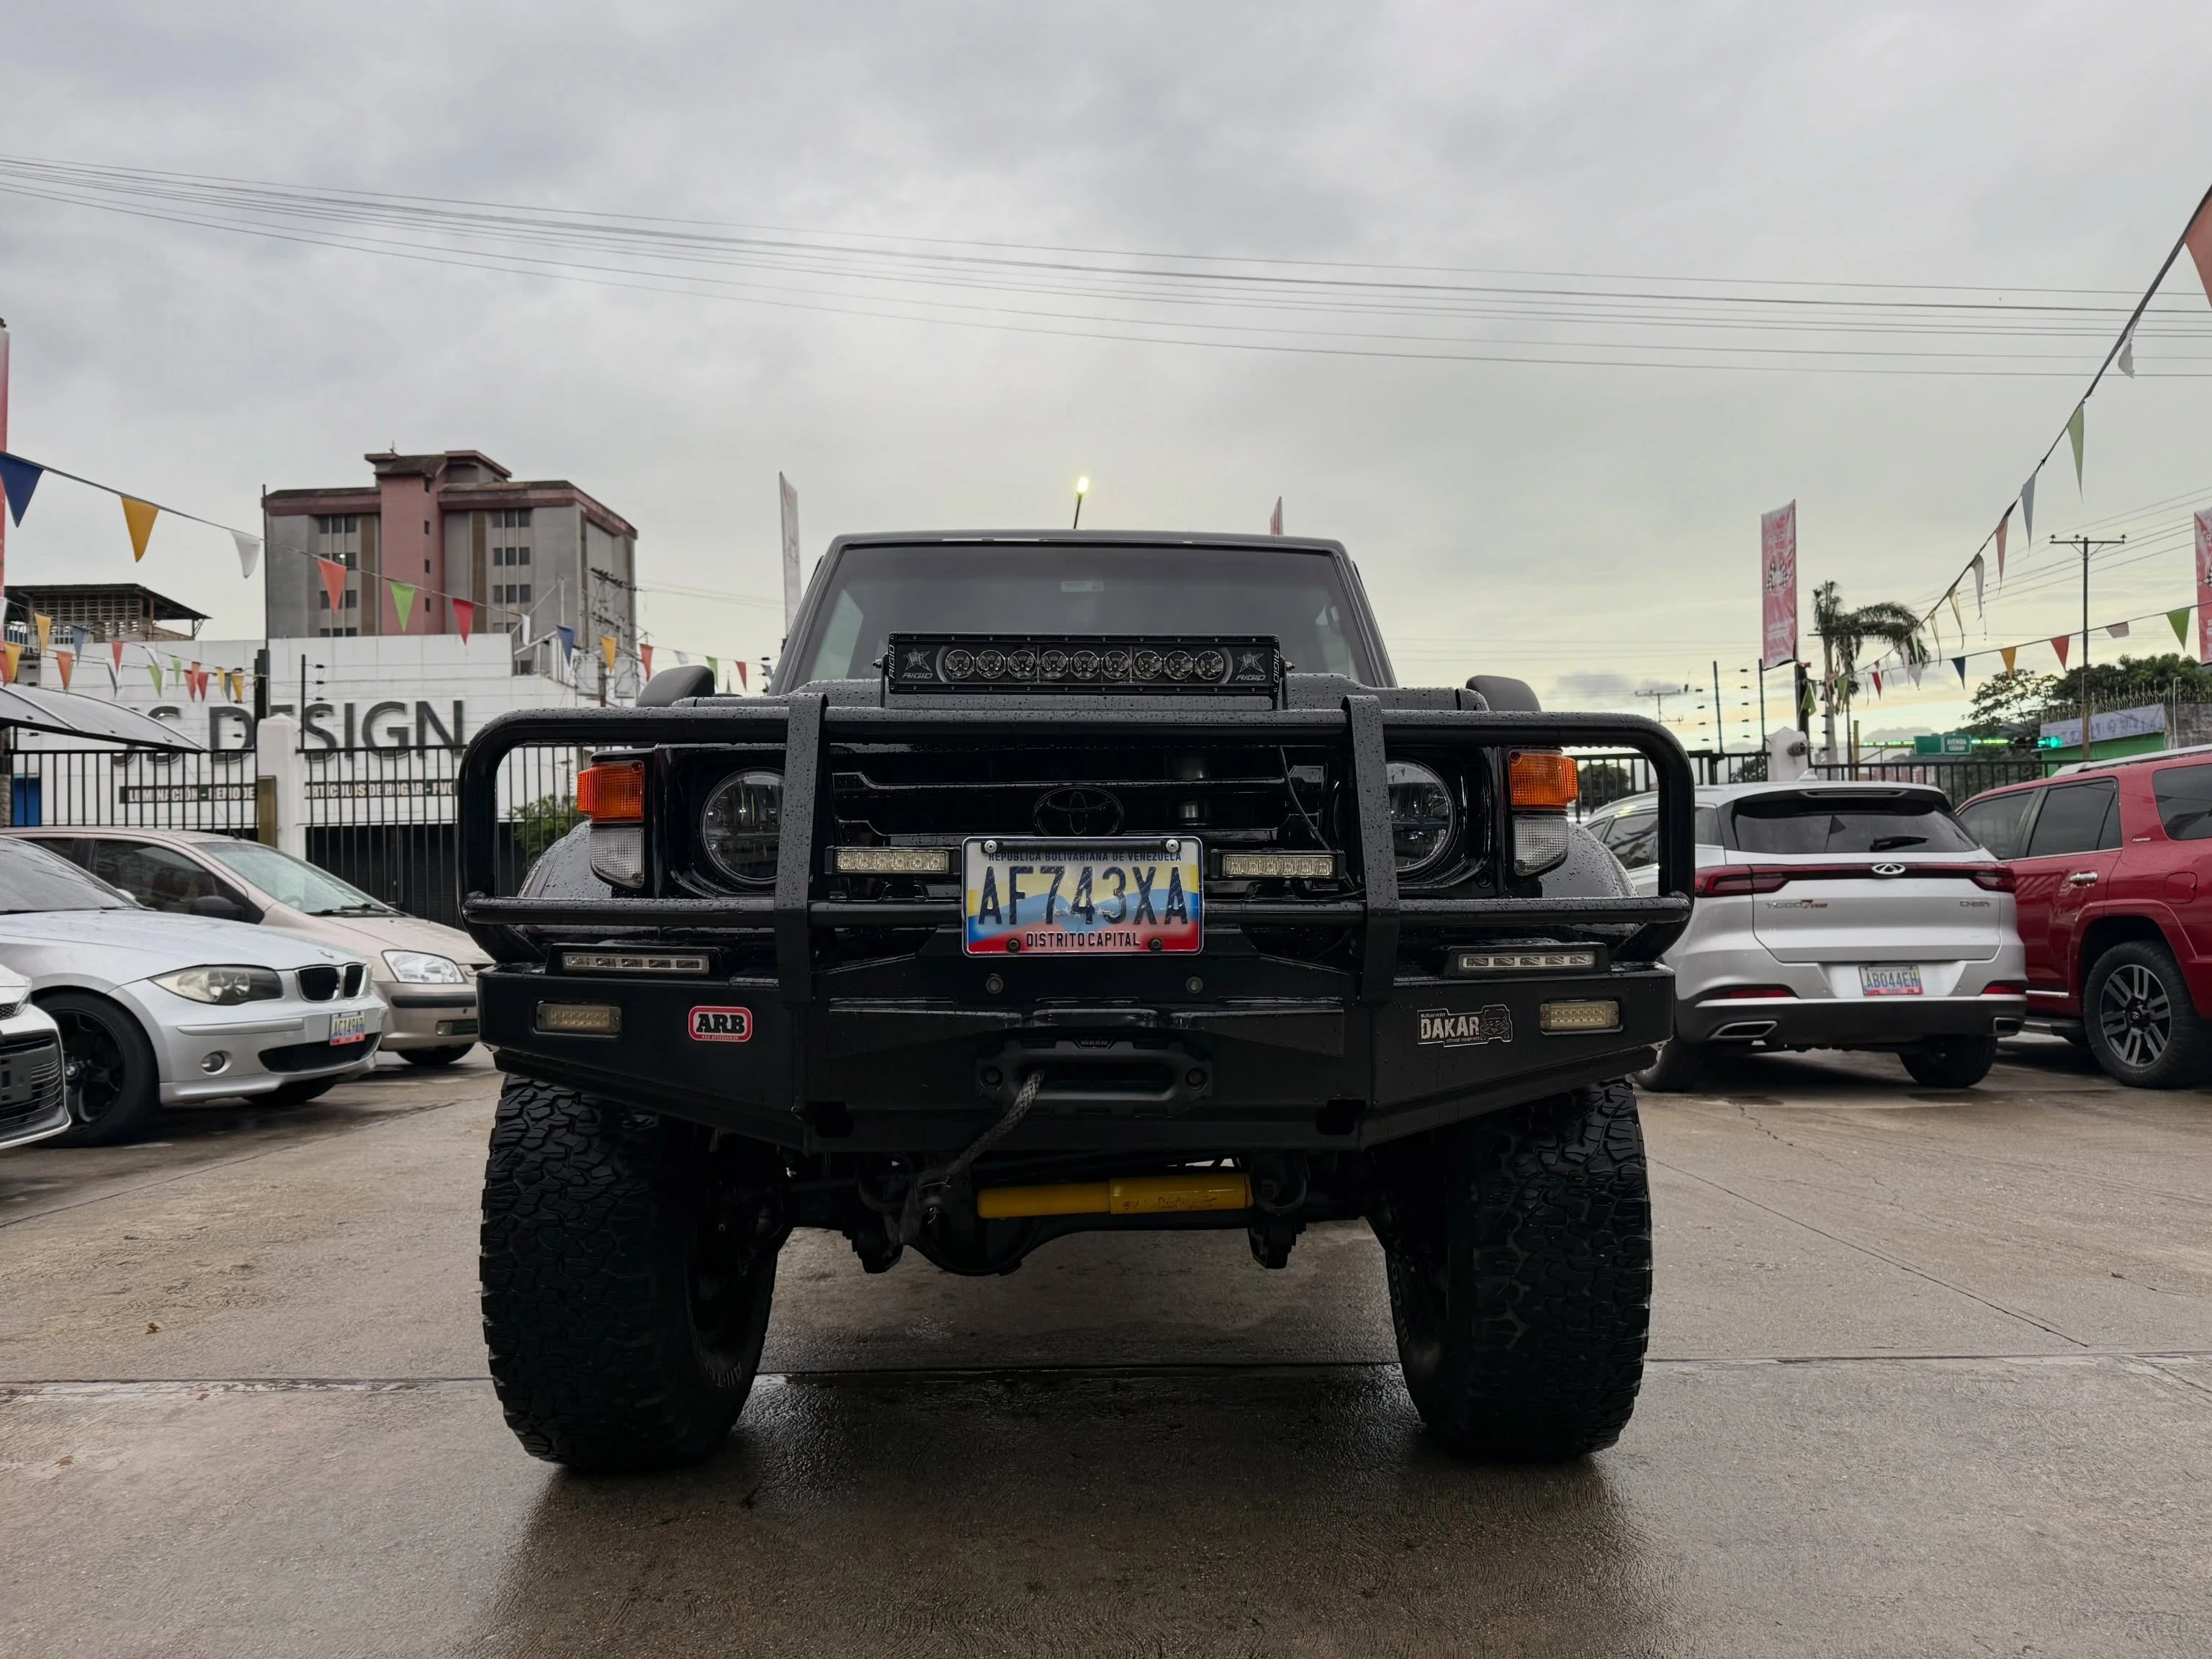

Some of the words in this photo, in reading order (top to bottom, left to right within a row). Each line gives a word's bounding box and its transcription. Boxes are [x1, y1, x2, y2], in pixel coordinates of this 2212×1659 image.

[210, 700, 463, 763] DSIGN
[1045, 852, 1108, 861] BOLIVARIANA
[1112, 852, 1124, 861] DE
[1128, 852, 1182, 861] VENEZUELA
[979, 866, 1188, 925] AF743XA
[1026, 932, 1084, 947] DISTRITO
[1088, 932, 1141, 947] CAPITAL
[696, 1013, 745, 1034] ARB
[1421, 1016, 1480, 1040] DAKAR
